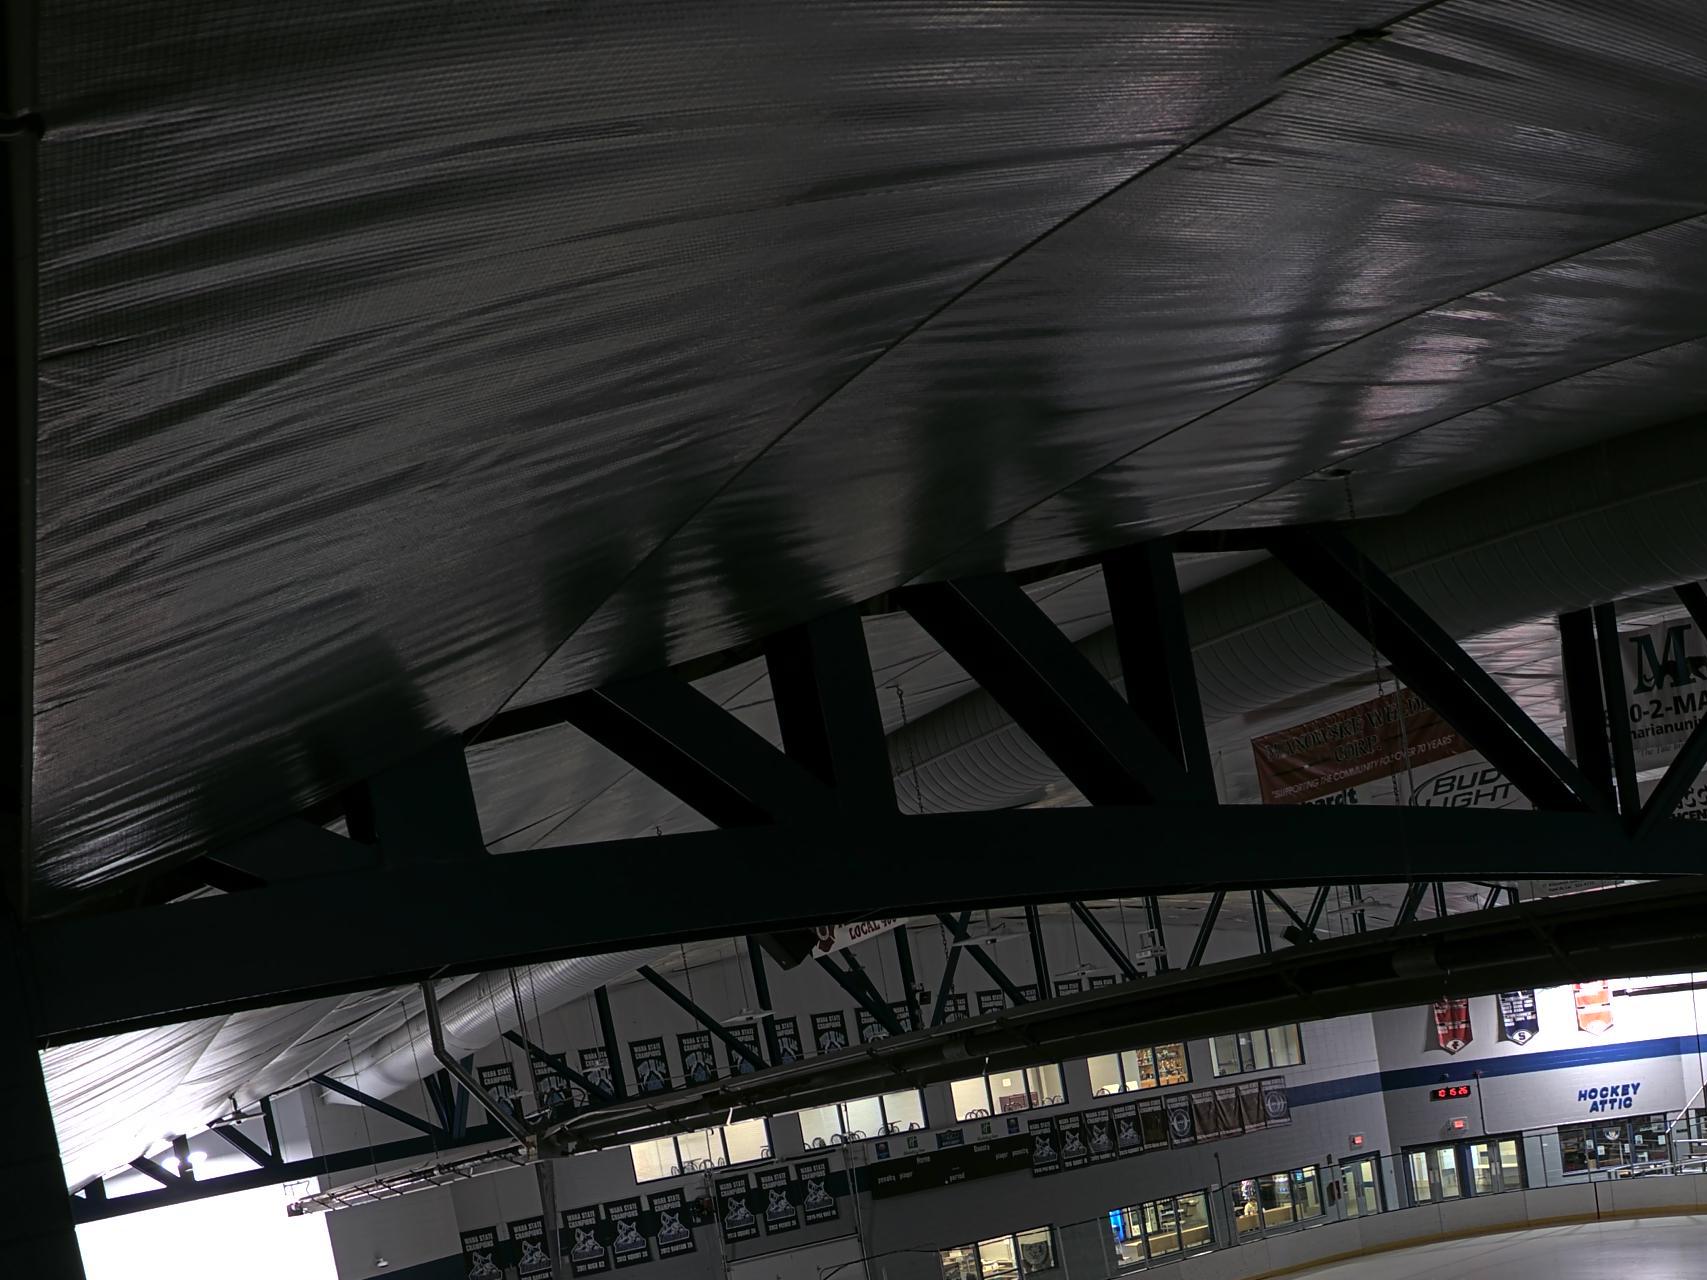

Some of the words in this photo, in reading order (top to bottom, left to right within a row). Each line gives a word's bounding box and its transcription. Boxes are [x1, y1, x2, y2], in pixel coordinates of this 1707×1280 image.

[1434, 768, 1502, 796] BUD
[1578, 1082, 1641, 1101] HOCKEY
[1589, 1096, 1633, 1113] ATTIC
